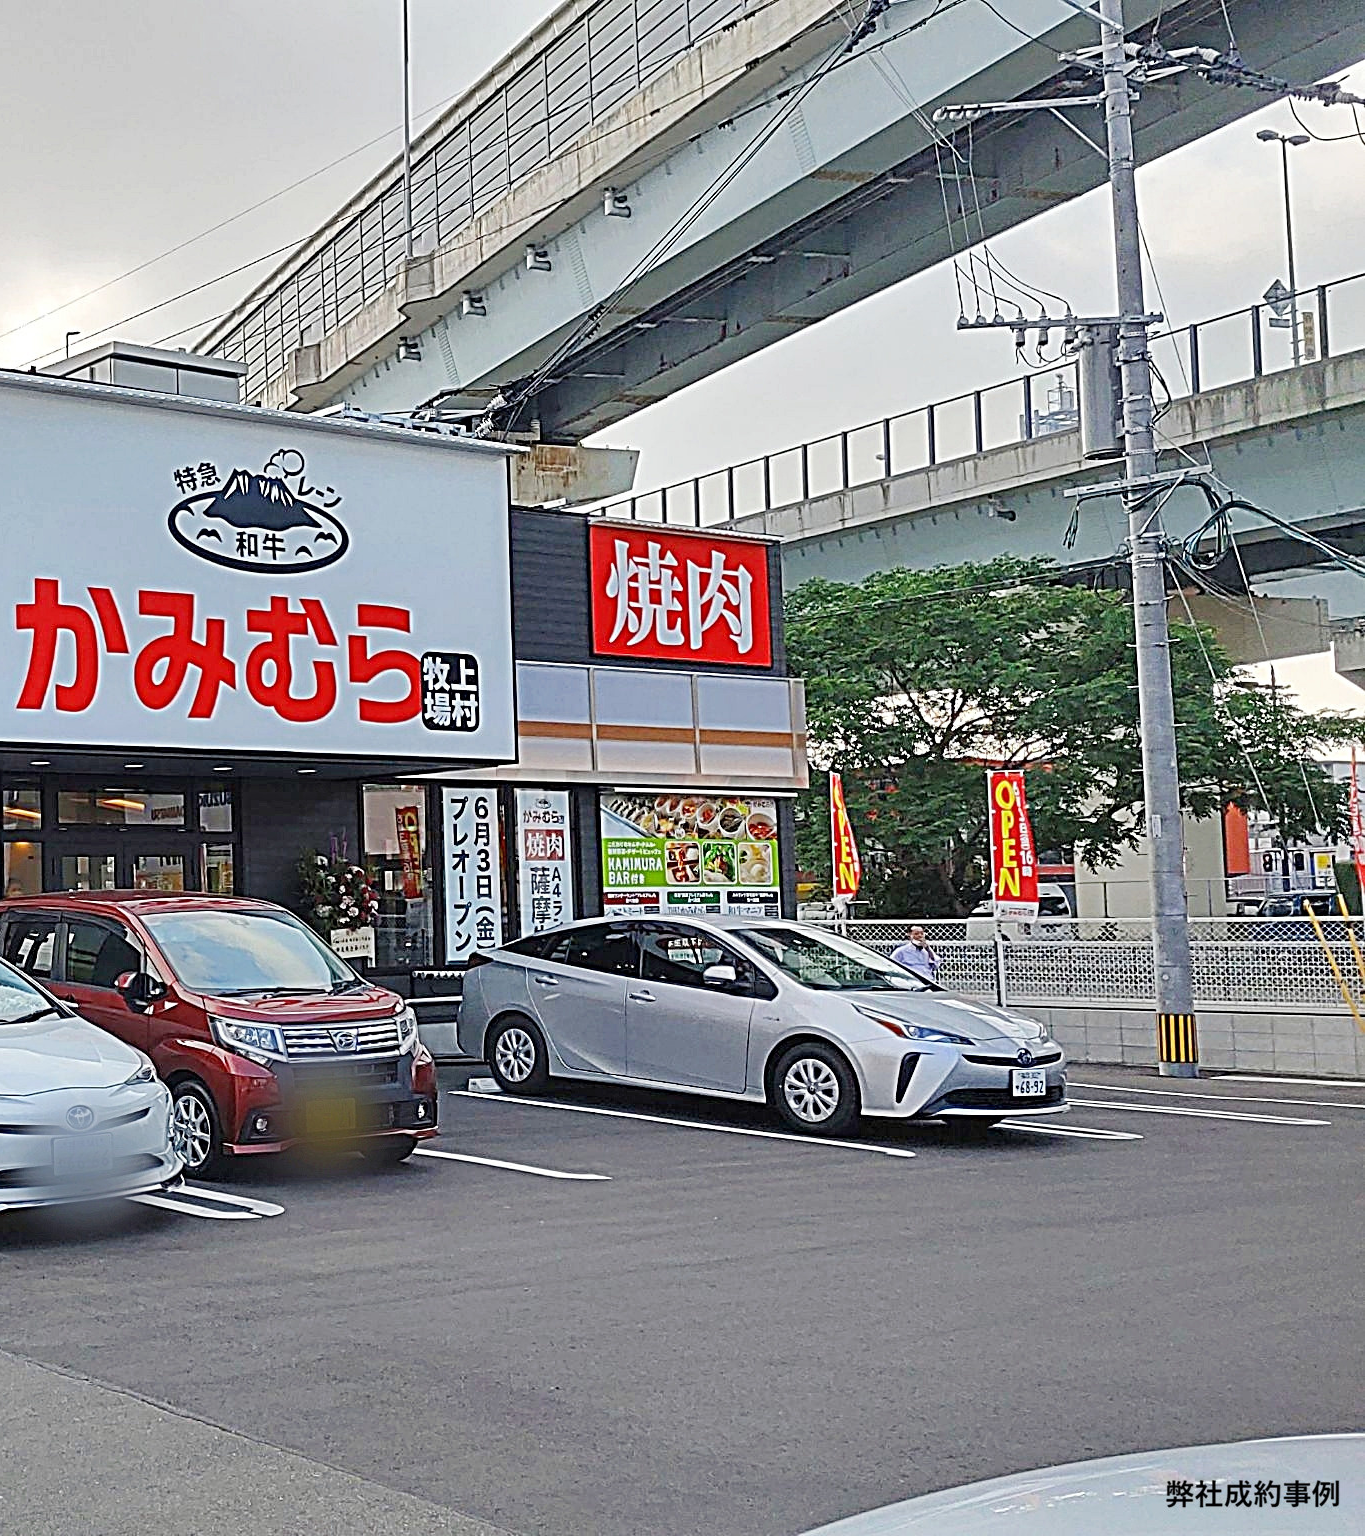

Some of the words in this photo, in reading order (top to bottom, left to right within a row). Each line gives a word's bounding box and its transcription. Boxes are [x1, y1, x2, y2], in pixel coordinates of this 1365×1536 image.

[174, 462, 222, 494] 特急
[298, 476, 343, 508] レーン
[236, 531, 286, 560] 和牛
[606, 539, 754, 654] 焼肉
[15, 577, 422, 724] かみむら
[526, 832, 563, 858] 焼肉
[607, 857, 663, 871] KAMIMURA
[995, 780, 1021, 897] OPEN
[450, 796, 473, 952] プレオープン
[551, 866, 564, 924] A4ラ
